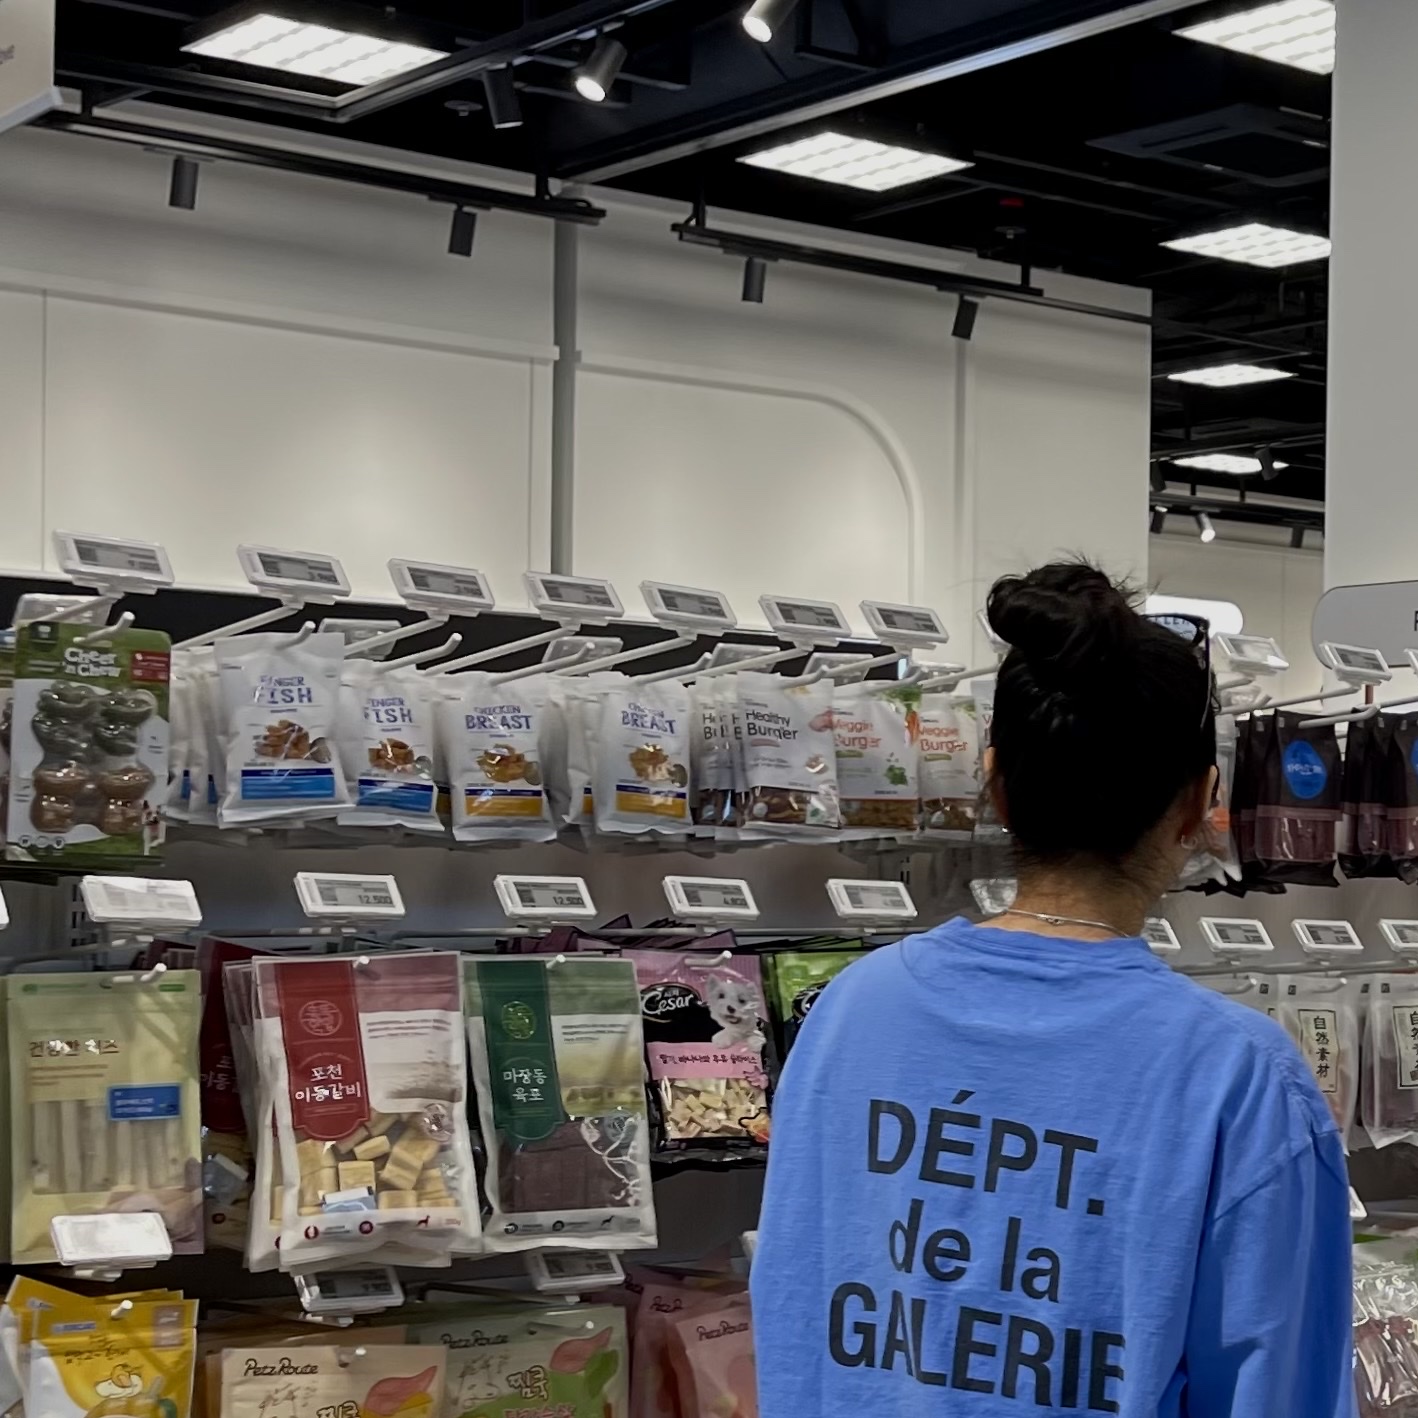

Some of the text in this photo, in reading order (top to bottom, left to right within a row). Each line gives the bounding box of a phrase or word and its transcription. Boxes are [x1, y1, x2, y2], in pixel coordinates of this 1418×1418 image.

[465, 714, 533, 730] BREAST
[621, 710, 676, 735] BREAST
[746, 711, 790, 727] Healthy
[747, 723, 798, 741] Burger
[920, 739, 967, 752] Burger
[643, 988, 694, 1015] Cesar
[1313, 1015, 1330, 1079] 自然素材
[310, 1064, 343, 1082] 포천
[503, 1067, 548, 1085] 마장동
[295, 1082, 361, 1102] 이동갈비
[512, 1087, 545, 1102] 육포
[867, 1089, 1105, 1216] DÉPT.
[889, 1197, 1061, 1303] de la
[828, 1281, 1126, 1413] GALERIE
